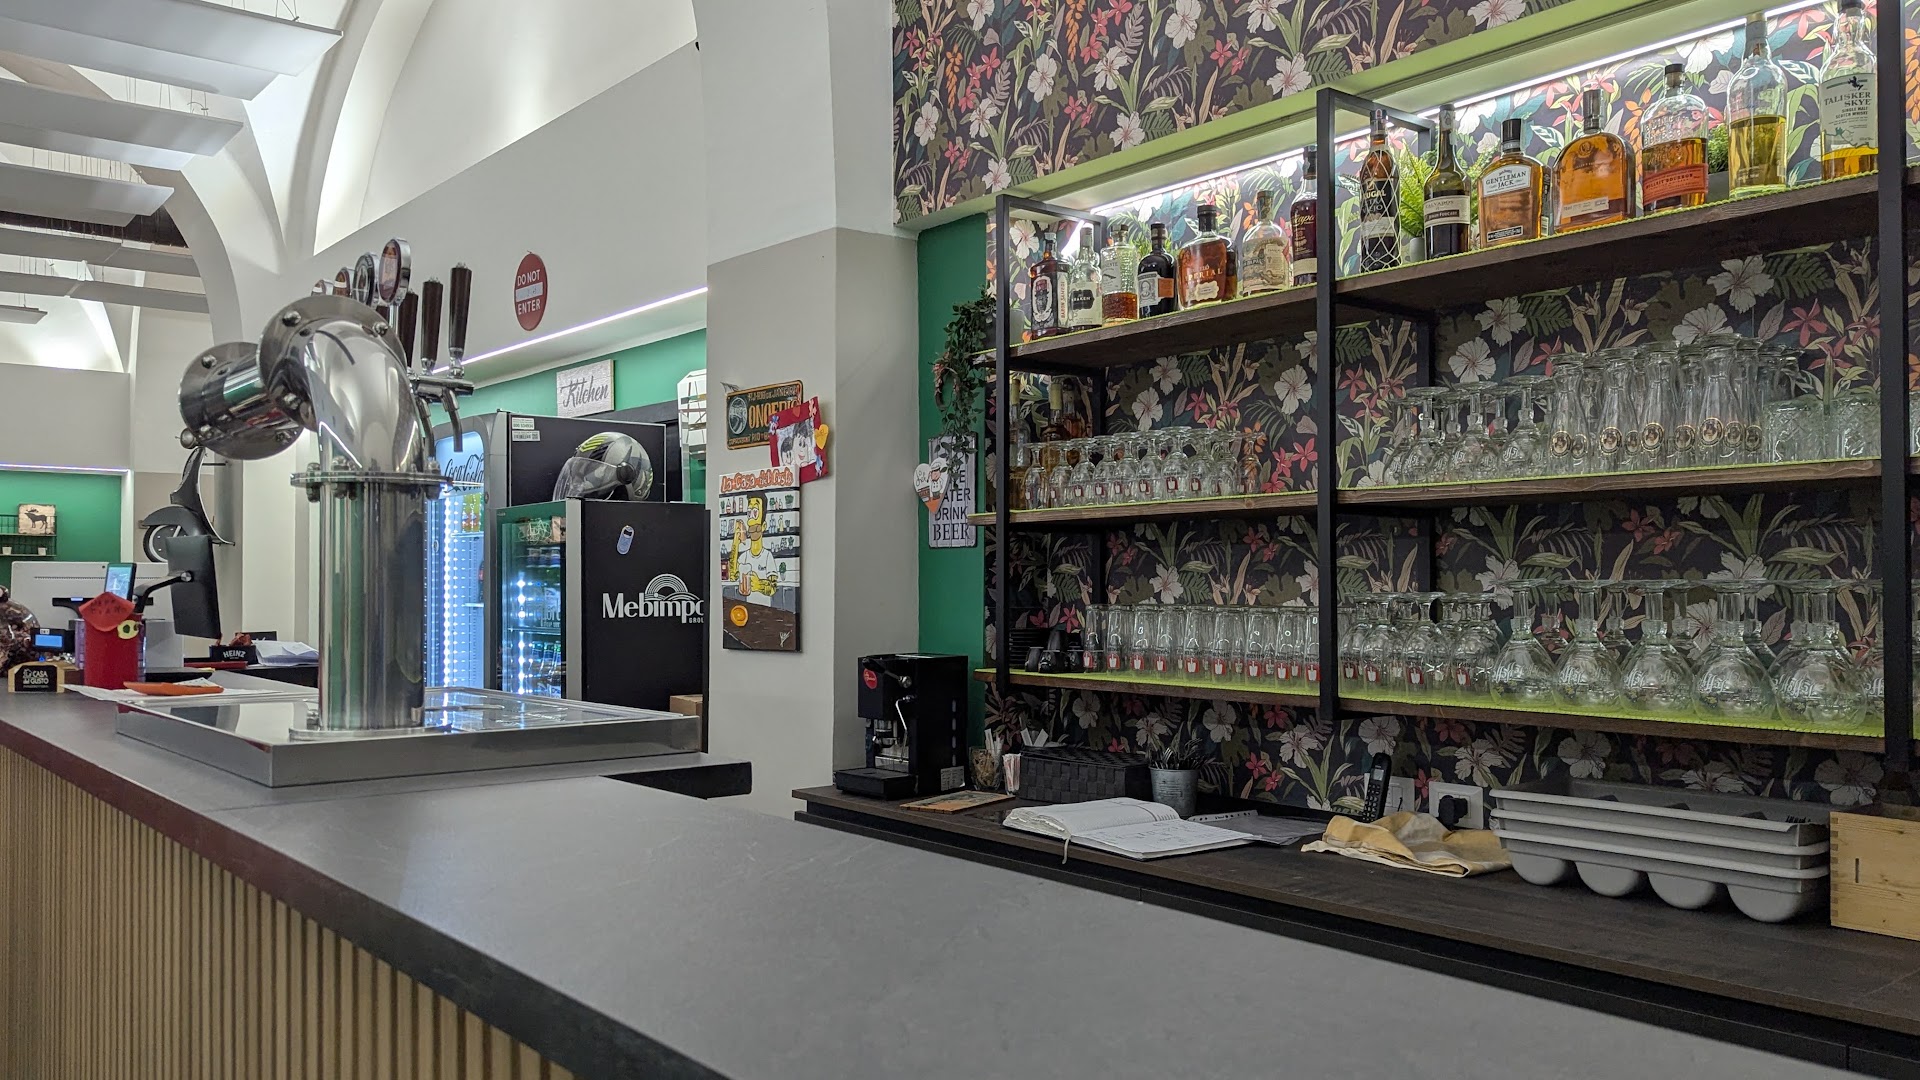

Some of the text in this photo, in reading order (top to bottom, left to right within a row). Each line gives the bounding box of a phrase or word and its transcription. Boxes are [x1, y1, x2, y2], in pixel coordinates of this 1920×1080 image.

[1824, 92, 1871, 105] TALISKER
[1844, 99, 1871, 107] SKYE
[1485, 171, 1527, 185] GENTLEMAN
[1497, 180, 1514, 189] JACK
[1361, 189, 1387, 199] UGAL
[517, 270, 540, 286] DO NOT
[517, 299, 540, 315] ENTER
[560, 375, 609, 408] Kitchen
[734, 472, 755, 489] Casa
[942, 488, 971, 502] ATER
[935, 506, 968, 521] DRINK
[933, 523, 970, 540] BEER
[223, 650, 246, 658] HEINZ
